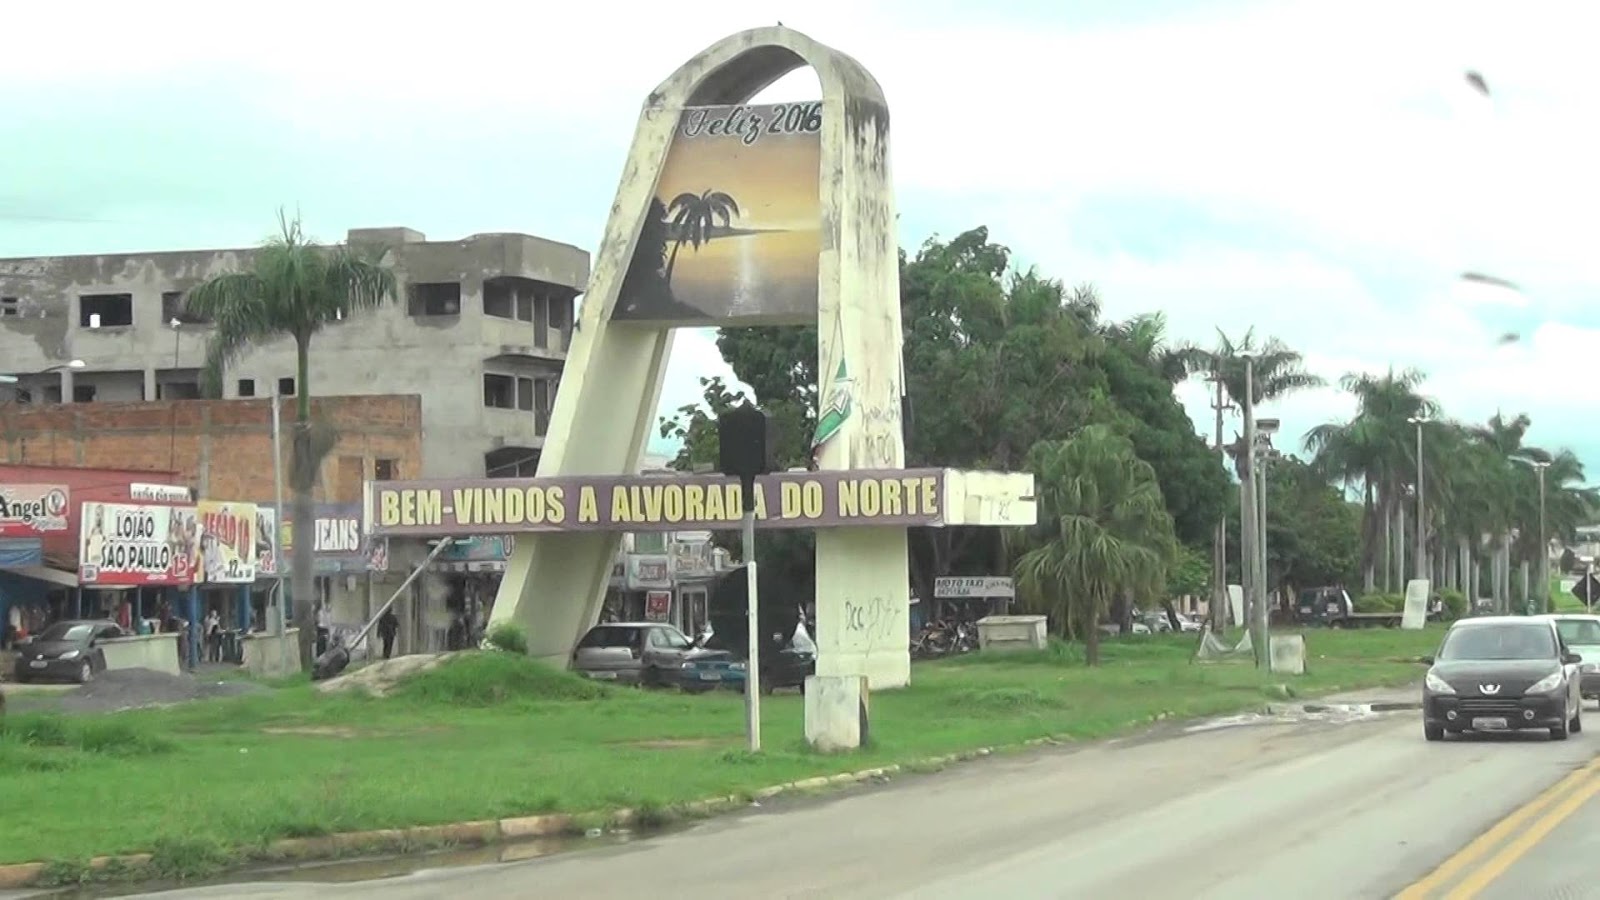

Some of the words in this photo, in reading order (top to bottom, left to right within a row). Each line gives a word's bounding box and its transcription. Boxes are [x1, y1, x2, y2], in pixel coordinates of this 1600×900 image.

[683, 105, 762, 145] Feliz
[767, 102, 823, 134] 2016
[380, 485, 566, 526] BEM-VINDOS
[578, 486, 599, 523] A
[610, 481, 768, 522] ALVORADA
[780, 480, 823, 519] DO
[838, 476, 938, 517] NORTE
[116, 511, 155, 538] LOJÃO
[314, 519, 359, 551] JEANS
[101, 539, 125, 568] SÃO
[128, 545, 169, 569] PAULO
